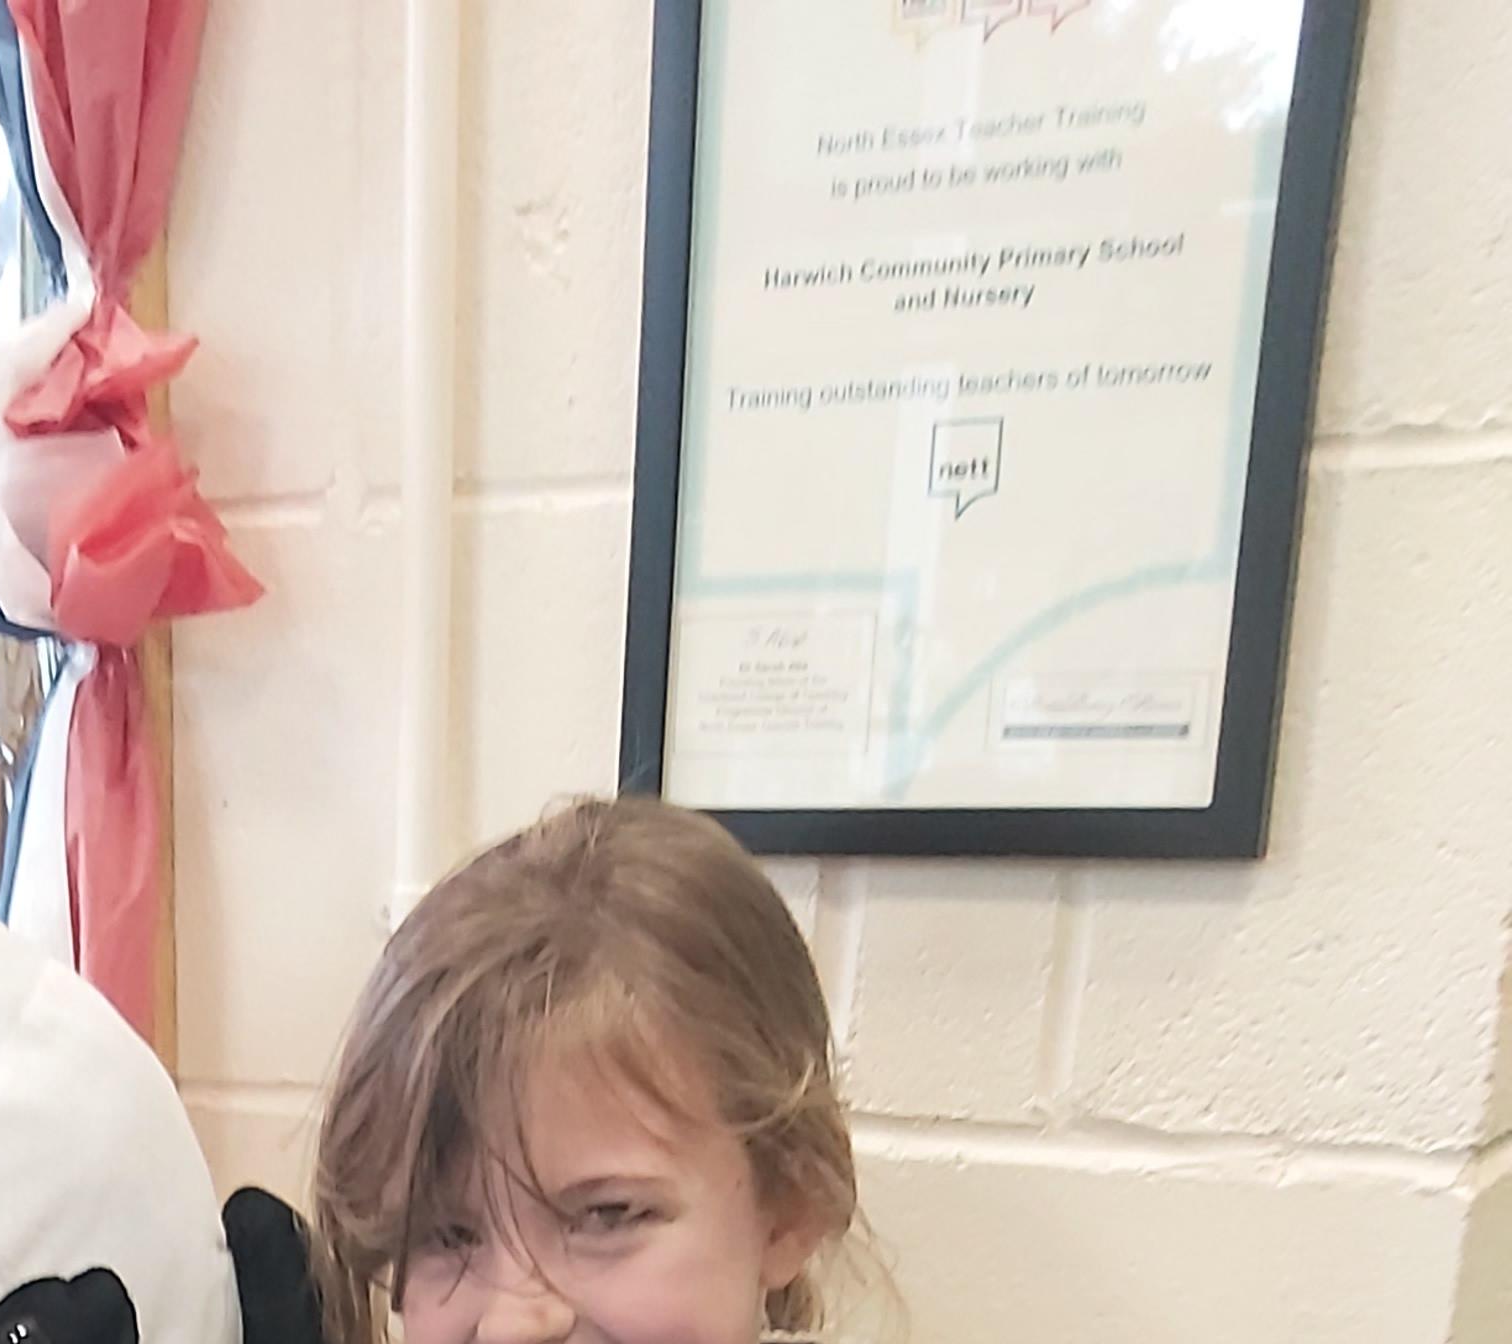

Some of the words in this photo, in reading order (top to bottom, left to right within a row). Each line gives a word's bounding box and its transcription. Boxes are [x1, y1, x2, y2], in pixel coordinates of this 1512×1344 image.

[817, 130, 874, 156] North
[882, 124, 946, 150] Essex
[955, 113, 1045, 142] Teacher
[1055, 100, 1147, 129] Training
[830, 180, 849, 201] is
[854, 169, 916, 204] proud
[922, 168, 943, 193] to
[948, 163, 977, 188] be
[985, 153, 1070, 184] working
[1078, 147, 1124, 175] with
[763, 262, 853, 290] Harwich
[859, 251, 991, 283] Community
[997, 243, 1090, 270] Primary
[1098, 232, 1186, 263] School
[893, 288, 936, 313] and
[942, 282, 1036, 309] Nursery
[727, 385, 813, 413] Training
[820, 376, 951, 405] outstanding
[958, 370, 1059, 398] teachers
[1067, 363, 1091, 390] of
[1097, 362, 1213, 389] tomorrow
[938, 457, 990, 482] nett
